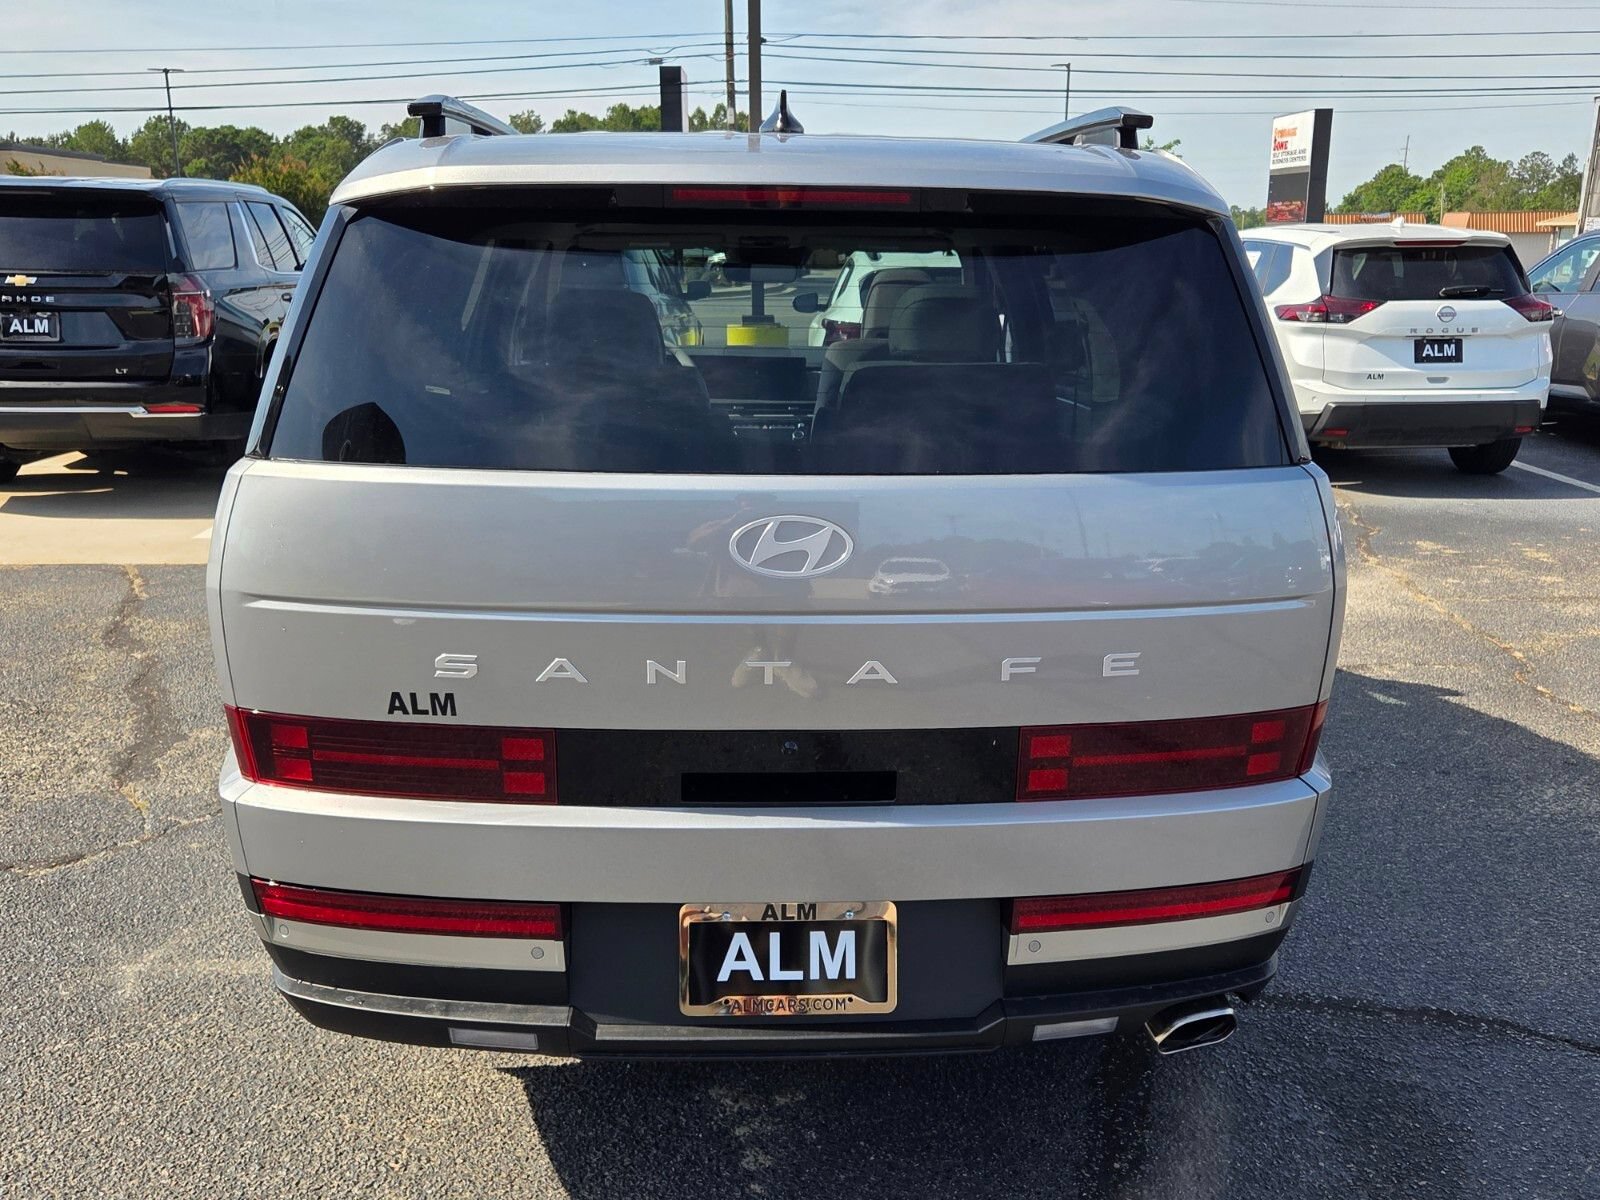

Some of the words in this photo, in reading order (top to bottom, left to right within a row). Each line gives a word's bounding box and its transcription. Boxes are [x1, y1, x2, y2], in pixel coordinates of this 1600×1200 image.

[1, 295, 55, 303] AHOE
[9, 318, 49, 333] ALM
[1422, 343, 1456, 357] ALM
[115, 367, 128, 375] LT
[433, 652, 898, 685] SANTA
[1001, 652, 1142, 681] FE
[387, 691, 457, 717] ALM
[761, 903, 817, 921] ALM
[716, 930, 856, 982] ALM
[730, 997, 847, 1014] ALMCARS.COM
